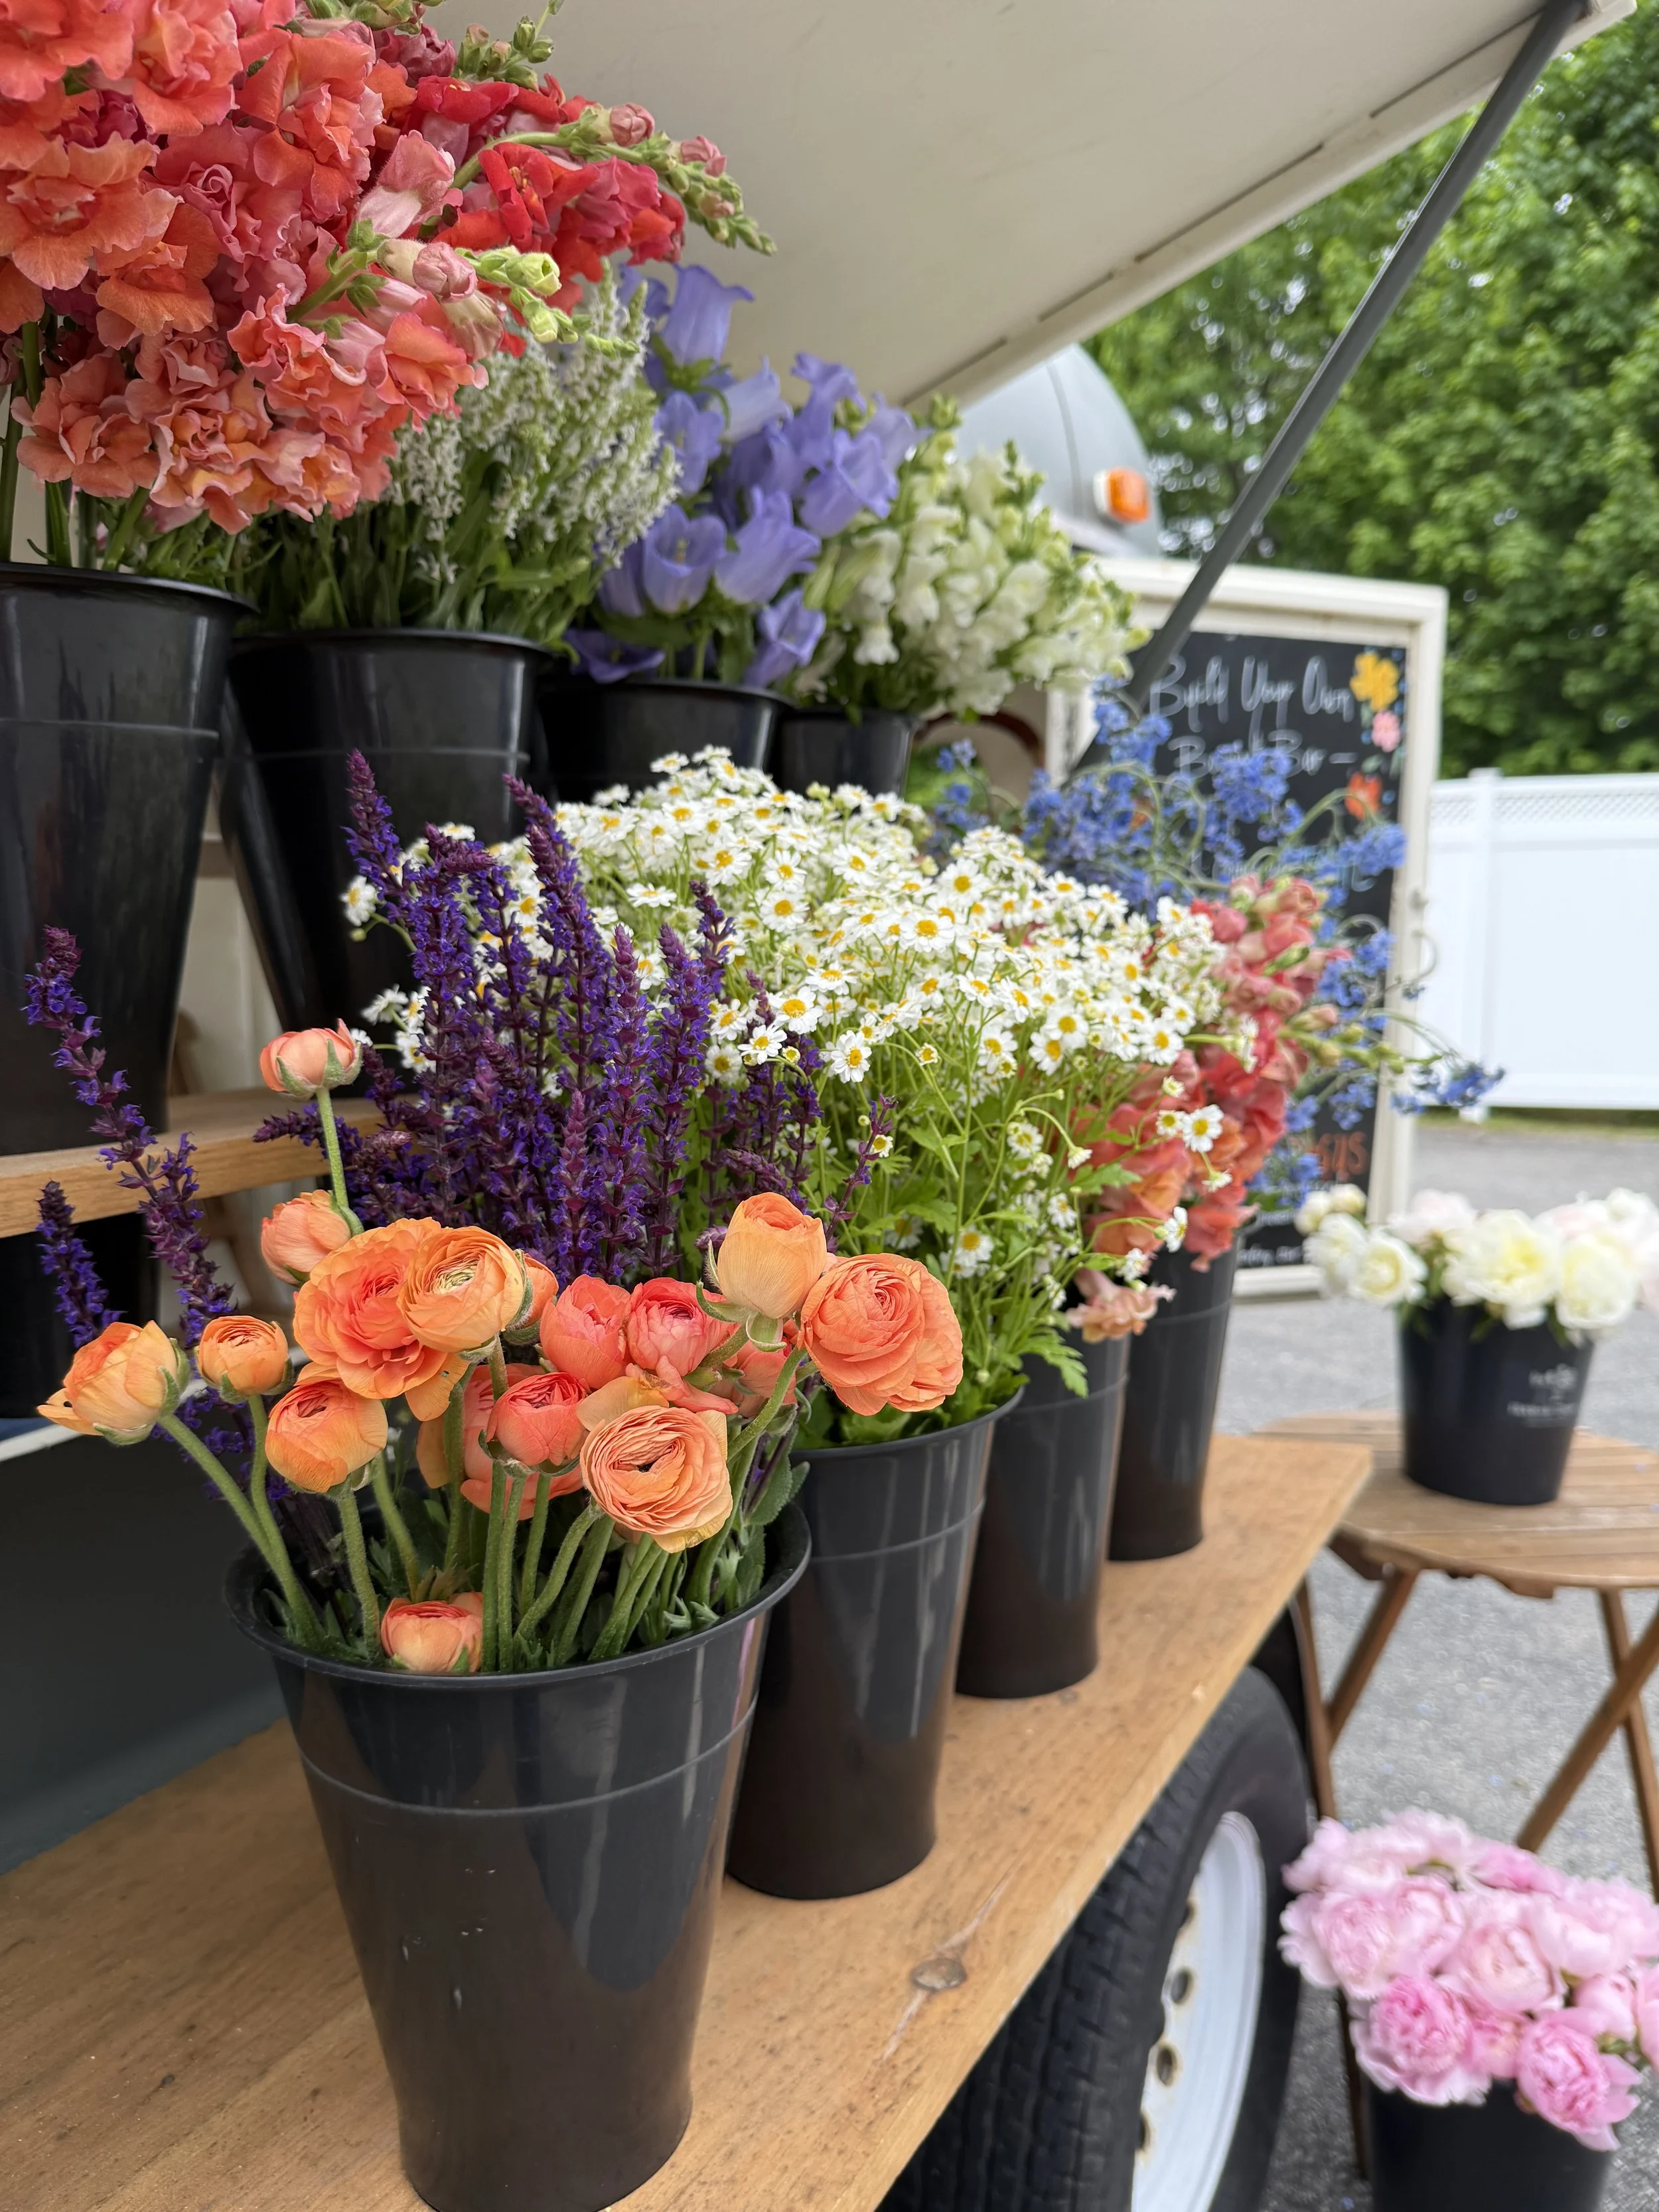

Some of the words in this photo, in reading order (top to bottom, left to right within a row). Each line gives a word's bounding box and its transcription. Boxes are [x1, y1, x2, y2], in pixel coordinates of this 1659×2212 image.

[1149, 654, 1230, 733] Build
[1240, 654, 1298, 751] Your
[1302, 654, 1355, 723] Own
